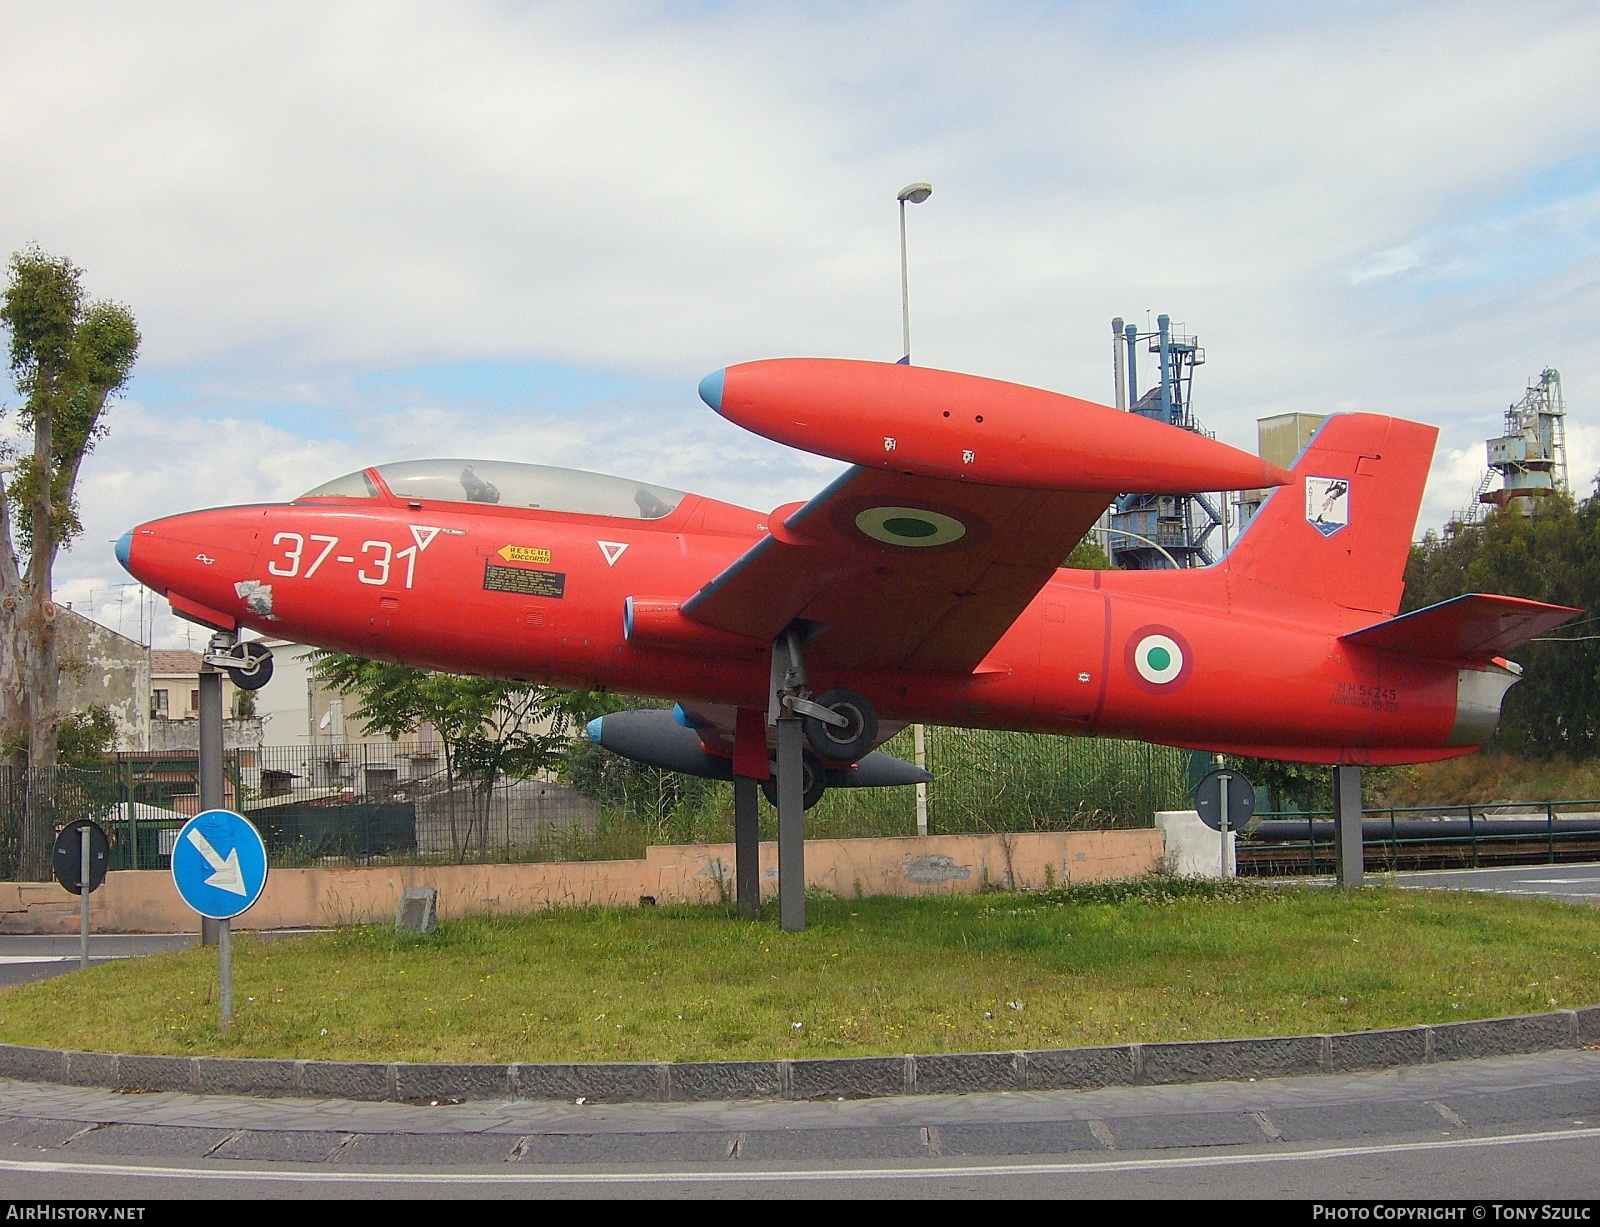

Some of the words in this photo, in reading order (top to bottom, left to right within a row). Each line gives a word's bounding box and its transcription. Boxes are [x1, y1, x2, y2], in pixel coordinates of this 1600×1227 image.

[510, 547, 550, 557] RESCUE
[268, 532, 417, 589] 37-31
[510, 553, 550, 563] SOCCORSO
